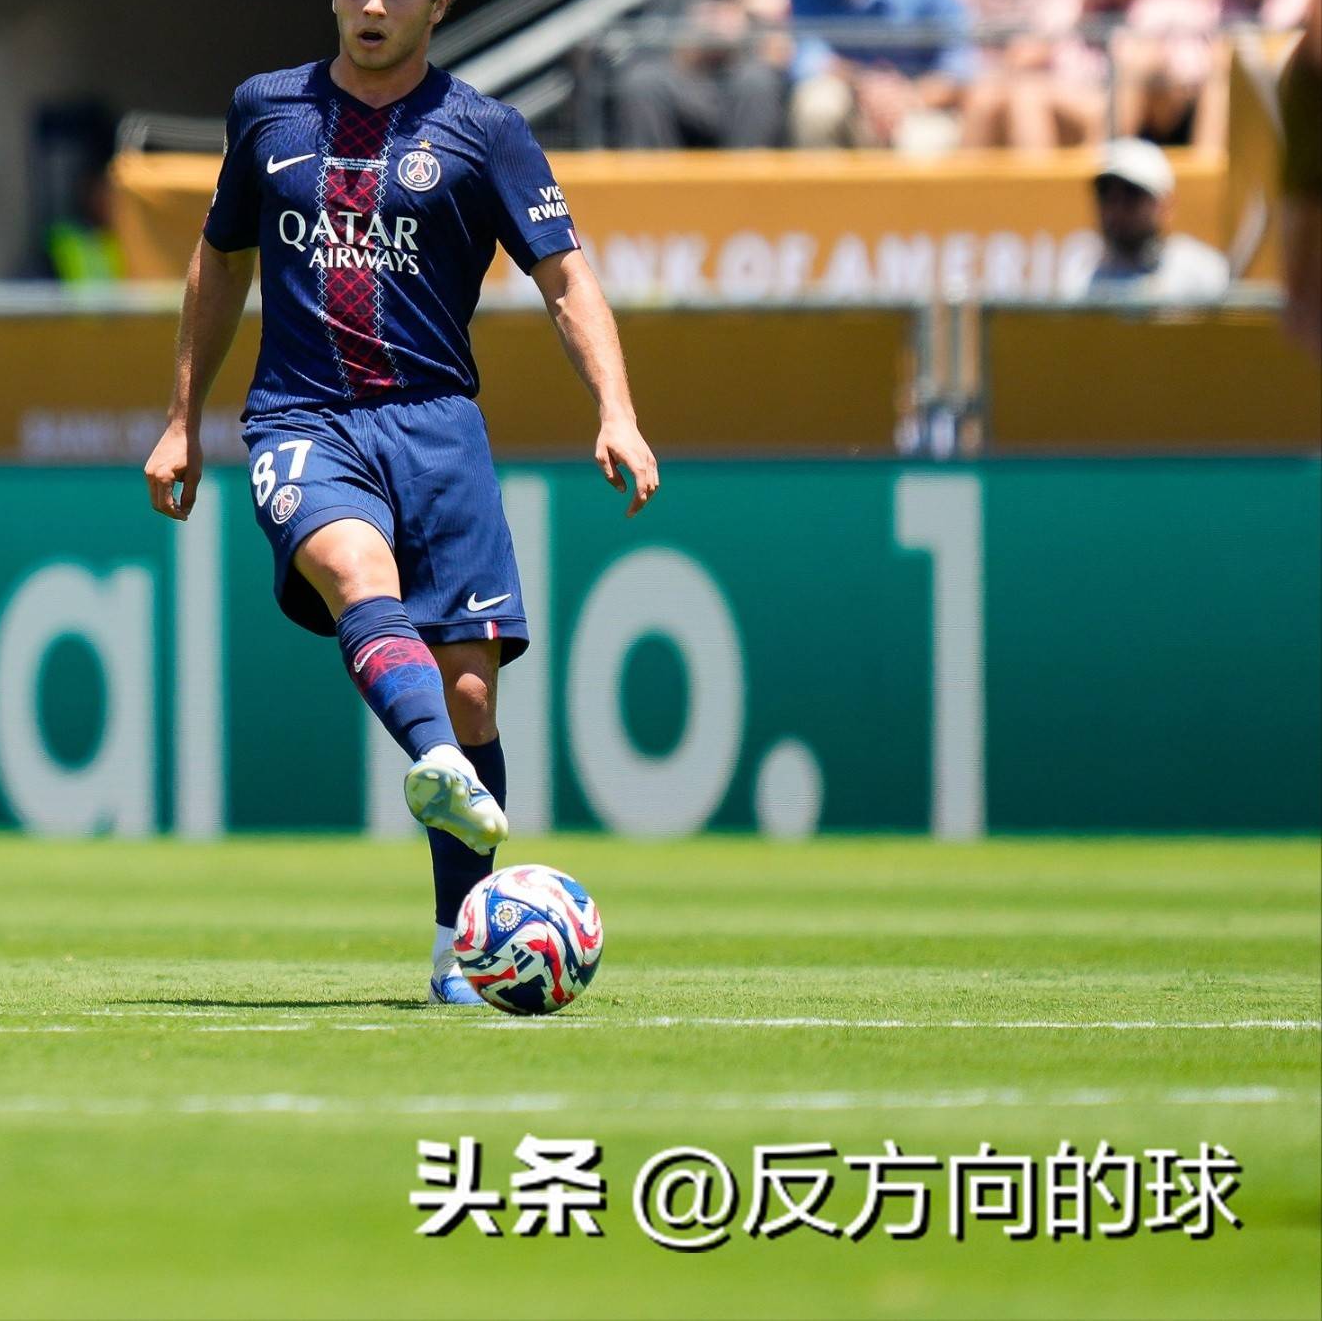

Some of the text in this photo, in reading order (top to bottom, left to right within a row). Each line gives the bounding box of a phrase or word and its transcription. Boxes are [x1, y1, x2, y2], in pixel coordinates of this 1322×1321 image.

[528, 201, 570, 223] RWA
[539, 185, 565, 203] VIS
[278, 209, 419, 253] QATAR
[308, 246, 420, 275] AIRWAYS
[719, 231, 820, 303] OF
[821, 230, 1107, 303] AMERIC
[252, 439, 313, 507] 87
